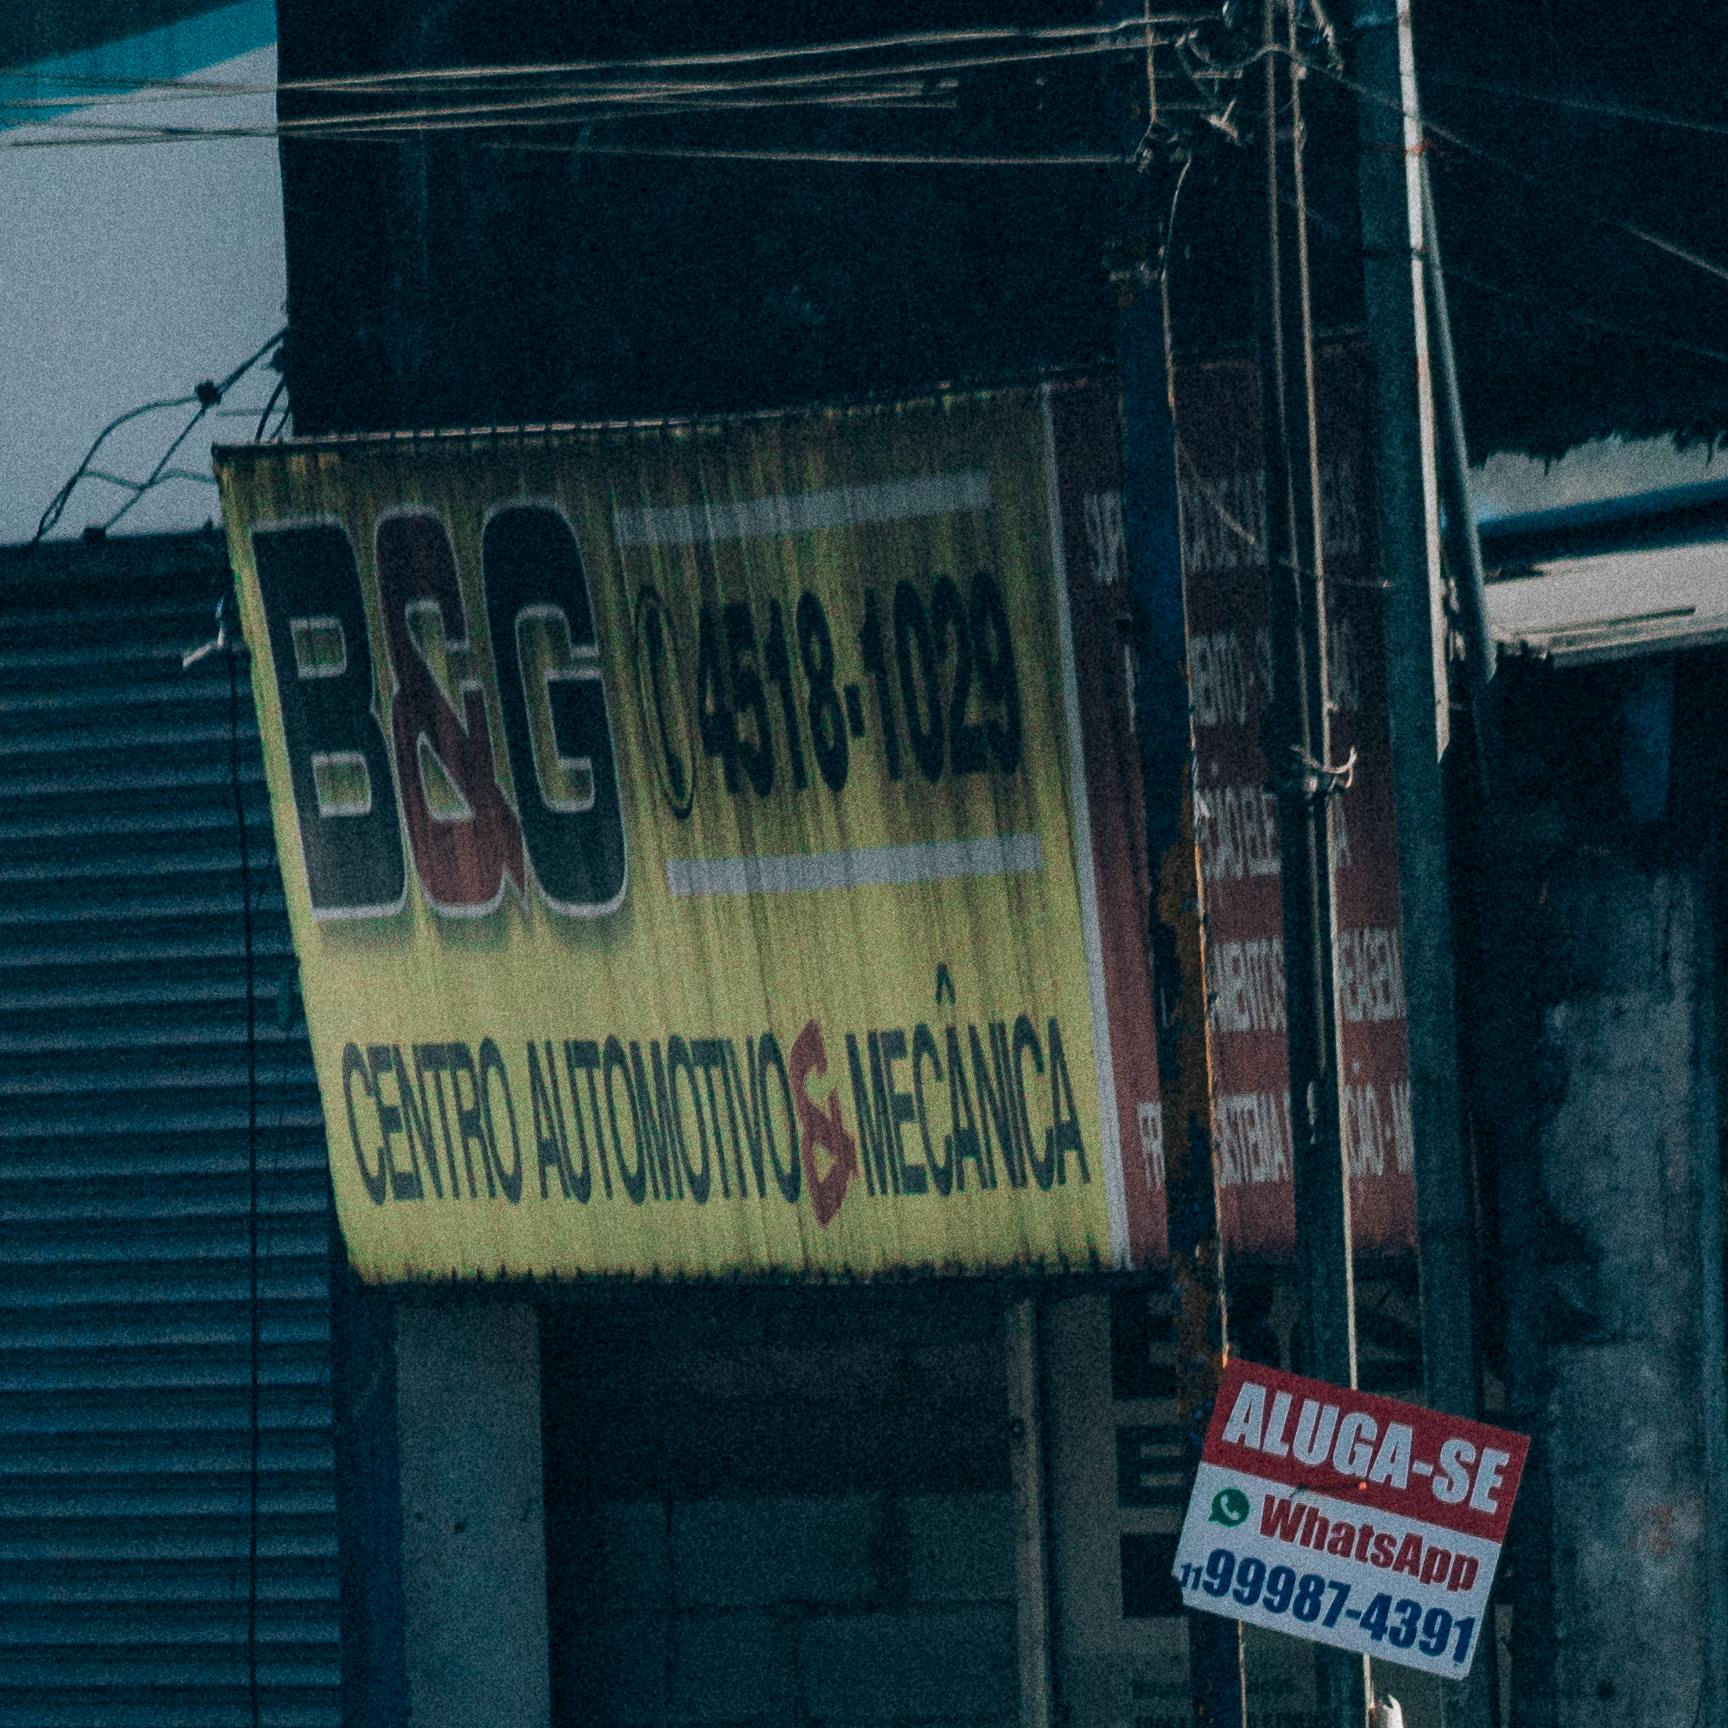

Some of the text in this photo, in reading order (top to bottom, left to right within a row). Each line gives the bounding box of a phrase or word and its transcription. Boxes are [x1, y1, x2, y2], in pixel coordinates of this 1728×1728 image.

[250, 498, 629, 920] B&G
[697, 571, 1021, 798] 4518-1029
[342, 1036, 523, 1204] CENTRO
[525, 1030, 801, 1205] AUTOMOTIVO
[788, 1018, 861, 1228] &
[846, 962, 1092, 1198] MECÂNICA
[1221, 1380, 1510, 1514] ALUGA-SE
[1259, 1493, 1480, 1593] WhatsApp
